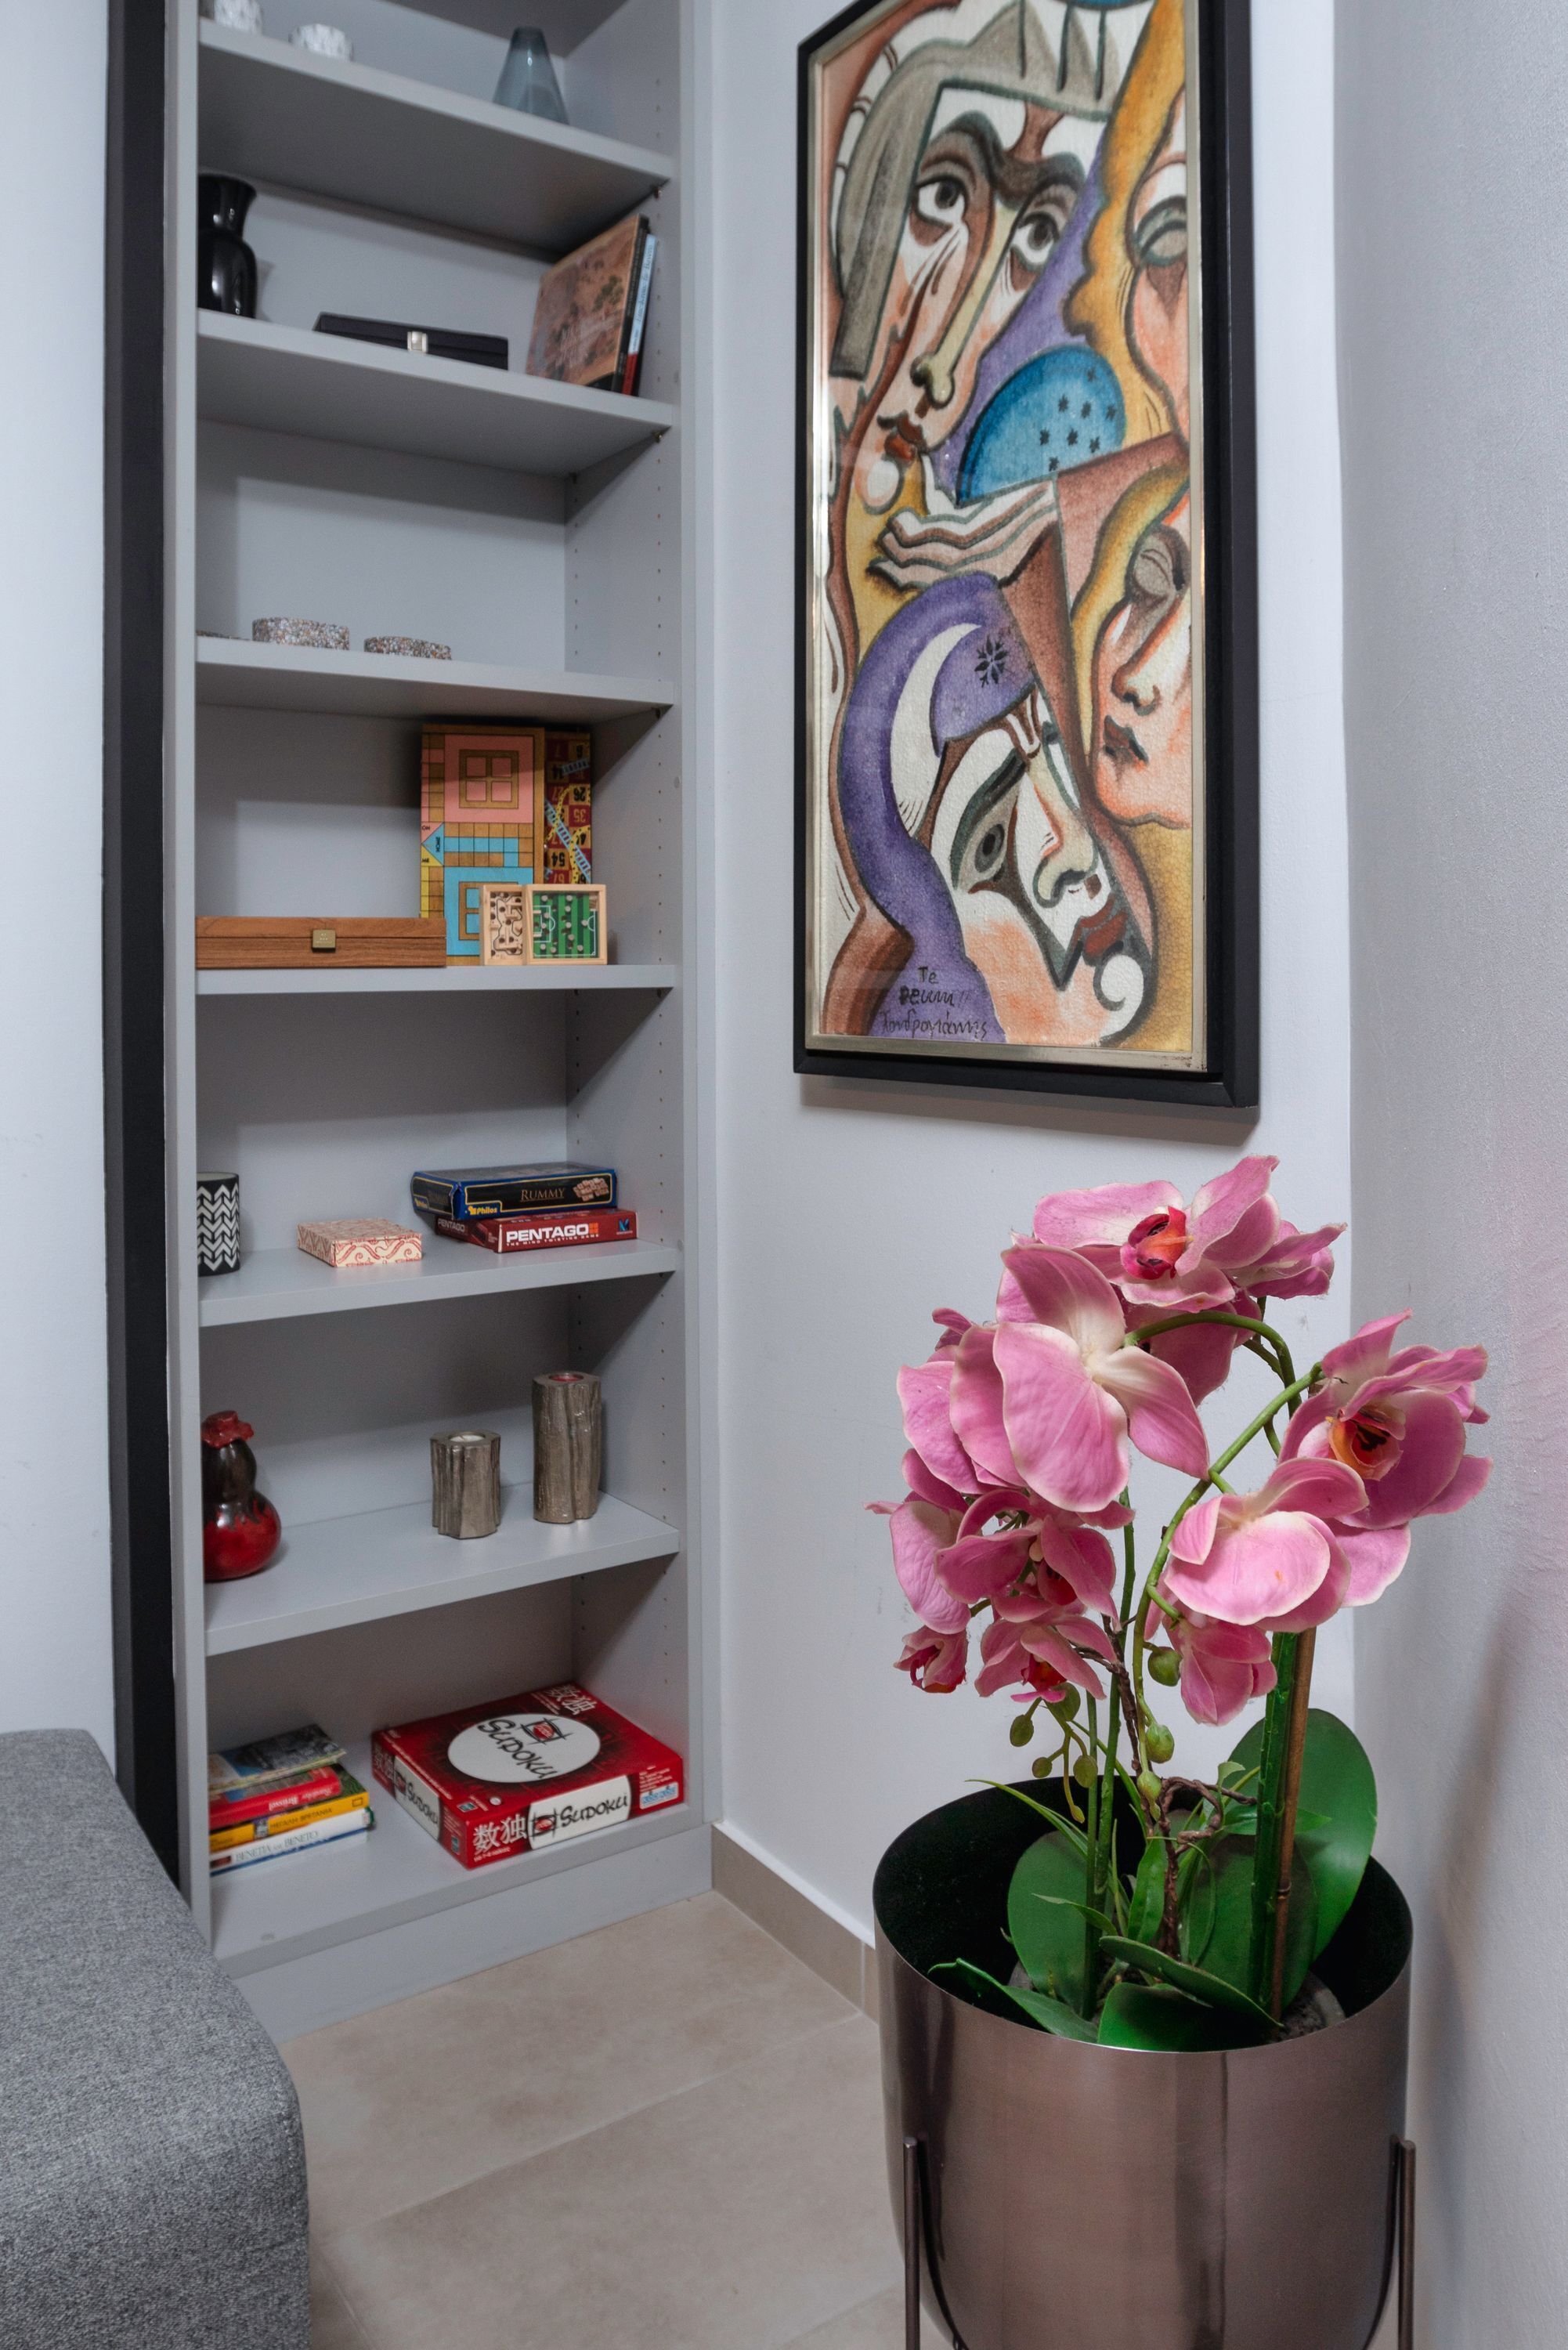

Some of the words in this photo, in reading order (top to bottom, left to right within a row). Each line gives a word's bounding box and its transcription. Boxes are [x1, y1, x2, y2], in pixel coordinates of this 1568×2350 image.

[573, 786, 586, 801] 26
[573, 808, 586, 823] 35
[551, 851, 565, 867] 54
[520, 1188, 565, 1201] RUMMY
[437, 1220, 466, 1232] PENTAGO
[506, 1223, 590, 1242] PENTAGO
